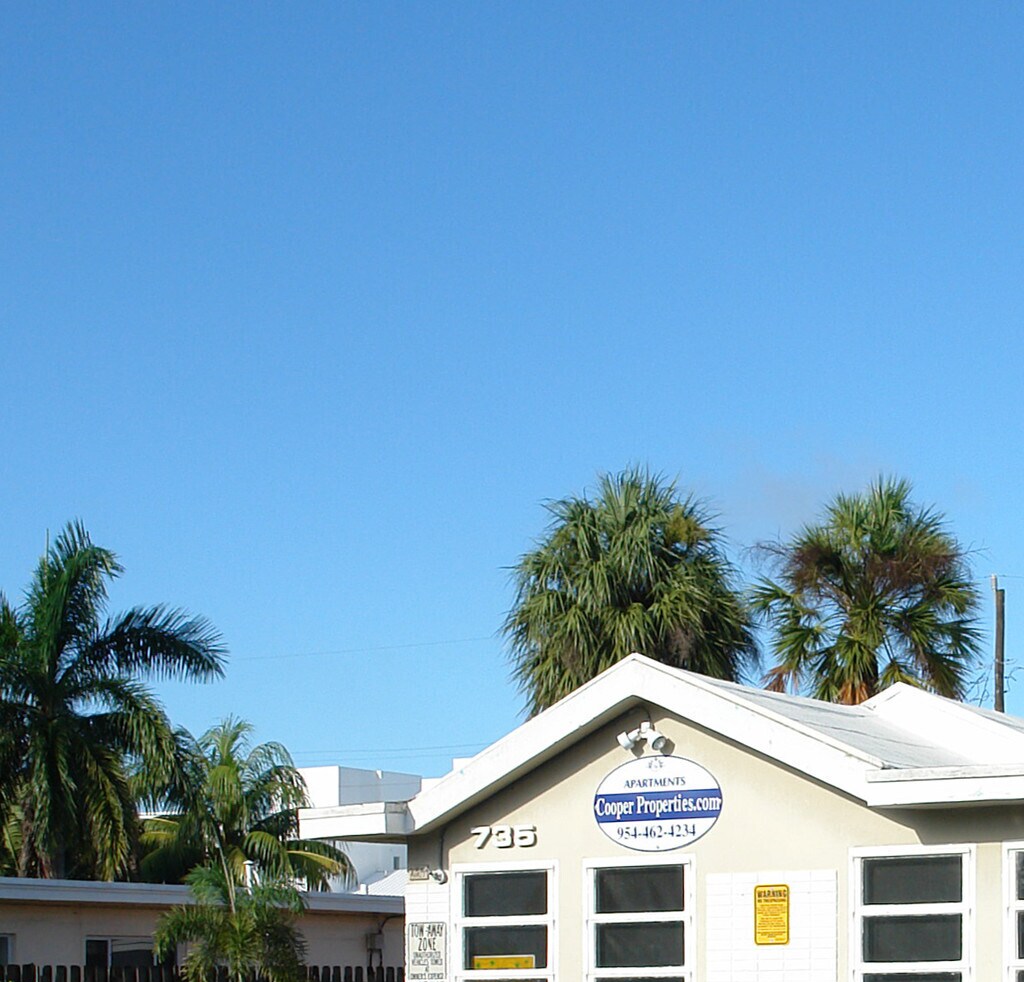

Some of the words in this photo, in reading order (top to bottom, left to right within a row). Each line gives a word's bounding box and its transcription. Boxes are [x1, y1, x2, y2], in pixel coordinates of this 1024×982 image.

[624, 776, 686, 788] APARTMENTS
[596, 797, 634, 819] Cooper
[635, 793, 721, 817] Properties.com
[470, 824, 537, 849] 735
[617, 823, 697, 840] 954-462-4234
[757, 889, 787, 898] WARNING
[418, 937, 436, 951] ZONE
